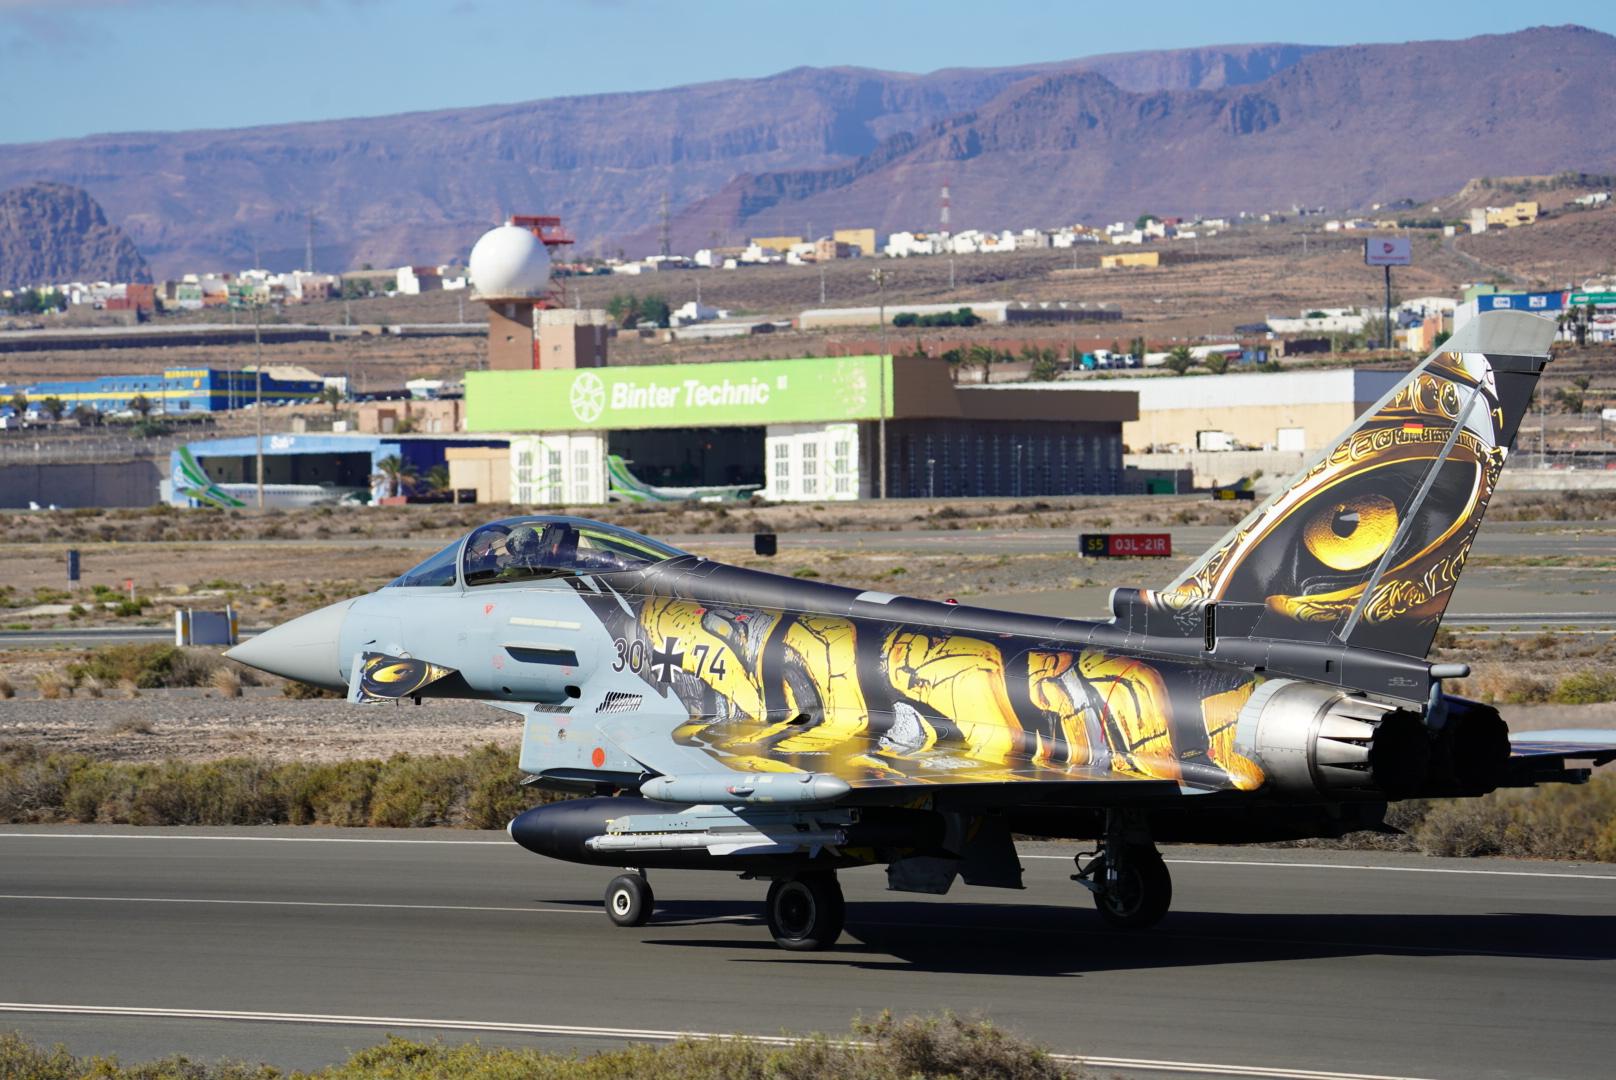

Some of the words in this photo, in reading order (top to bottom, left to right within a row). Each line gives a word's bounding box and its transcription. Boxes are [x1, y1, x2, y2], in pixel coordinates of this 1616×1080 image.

[610, 382, 680, 409] Binter
[683, 377, 770, 407] Technic
[1088, 538, 1104, 551] S5
[1115, 538, 1165, 551] 03L-21R
[612, 637, 645, 674] 30
[693, 644, 726, 681] 74
